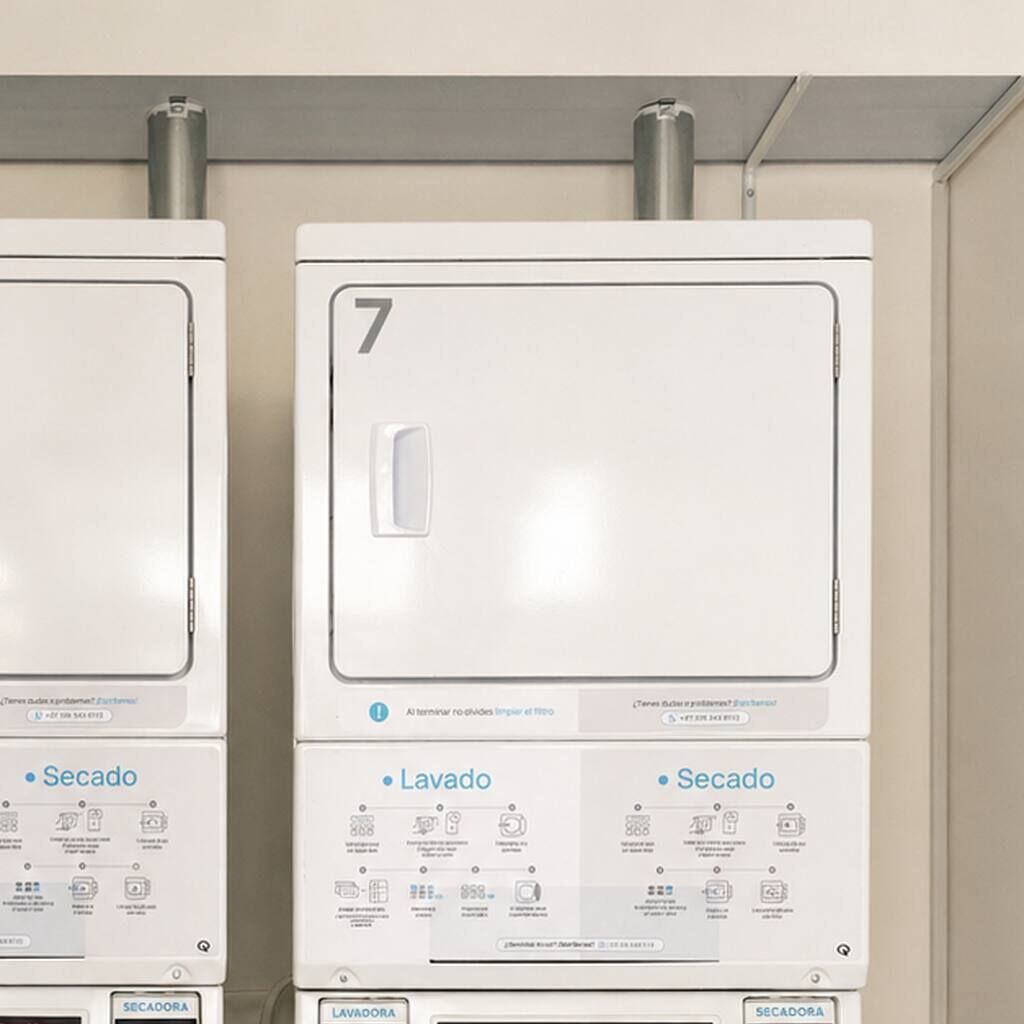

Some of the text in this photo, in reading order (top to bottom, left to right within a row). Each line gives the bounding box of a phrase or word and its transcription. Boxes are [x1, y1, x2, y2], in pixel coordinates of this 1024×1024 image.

[355, 298, 392, 353] 7
[406, 707, 415, 716] Al
[416, 707, 451, 716] terminar
[453, 707, 463, 716] no
[464, 707, 493, 716] olvides
[43, 765, 137, 786] Secado
[401, 768, 492, 789] Lavado
[677, 767, 775, 789] Secado
[123, 1002, 189, 1012] SECADORA
[332, 1008, 396, 1018] LAVADORA
[756, 1007, 824, 1017] SECADORA
